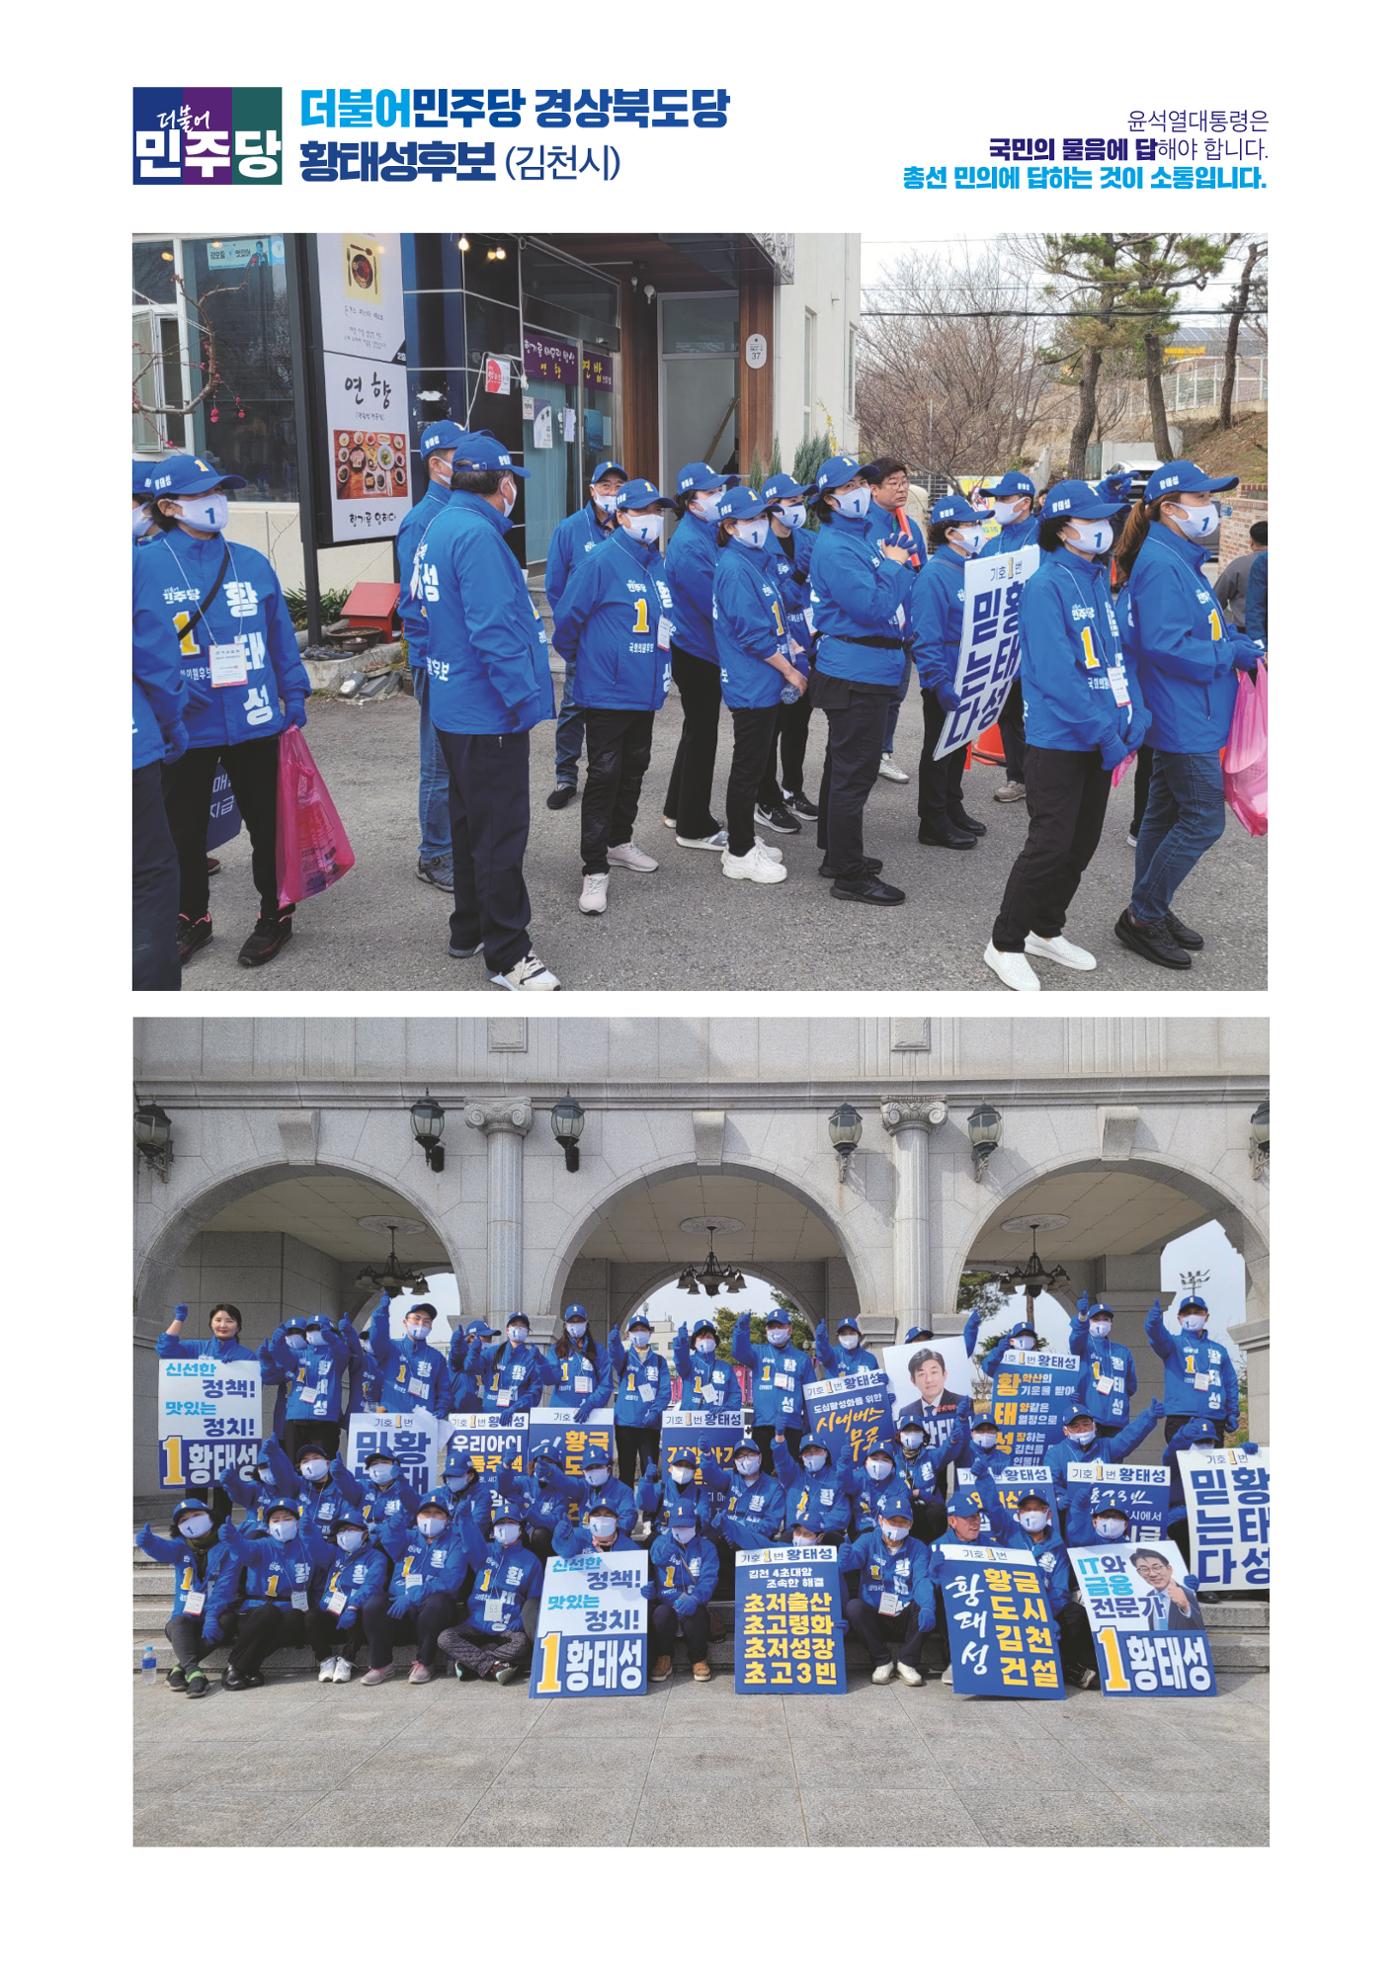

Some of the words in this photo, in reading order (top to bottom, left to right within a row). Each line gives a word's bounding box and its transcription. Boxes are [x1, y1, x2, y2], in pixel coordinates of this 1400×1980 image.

[852, 499, 860, 513] 1
[205, 508, 216, 524] 1
[793, 513, 800, 524] 1
[1201, 516, 1211, 532] 1
[640, 528, 649, 540] 1
[752, 532, 759, 544] 1
[973, 535, 981, 548] 1
[1094, 532, 1103, 548] 1
[990, 566, 1006, 582] 기호
[632, 598, 649, 632] 1
[772, 600, 784, 636] 1
[1208, 608, 1223, 641] 1
[172, 610, 200, 656] 1
[1081, 626, 1101, 669] 1
[944, 588, 1000, 752] 믿는다
[166, 1363, 216, 1377] 신선한
[1038, 1354, 1076, 1369] 황태성
[1184, 1355, 1196, 1374] 1
[396, 1365, 406, 1383] 1
[561, 1363, 569, 1381] 1
[761, 1365, 770, 1381] 1
[844, 1372, 880, 1389] 황태성
[202, 1379, 255, 1398] 정책!
[627, 1374, 635, 1391] 1
[165, 1402, 216, 1415] 맛있는
[554, 1413, 570, 1421] 기호
[994, 1402, 1018, 1425] 태
[203, 1418, 255, 1437] 정치!
[375, 1418, 393, 1427] 기호
[488, 1416, 524, 1427] 황성
[666, 1416, 683, 1424] 기호
[705, 1413, 741, 1426] 황태성
[816, 1407, 885, 1433] 시내버스
[452, 1435, 522, 1452] 우리아이
[163, 1436, 186, 1485] 1
[188, 1444, 258, 1484] 황태성
[1206, 1455, 1226, 1464] 기호
[1004, 1470, 1047, 1481] 황태성
[1072, 1469, 1092, 1478] 기호
[1119, 1468, 1166, 1483] 황태성
[1190, 1469, 1237, 1584] 믿는다
[1232, 1467, 1270, 1584] 황태성
[787, 1548, 833, 1561] 황태성
[402, 1556, 414, 1578] 1
[553, 1557, 602, 1572] 신선한
[749, 1569, 769, 1579] 김천
[1077, 1555, 1127, 1575] IT와
[181, 1566, 193, 1590] 1
[267, 1575, 279, 1597] 1
[481, 1569, 491, 1592] 1
[587, 1570, 641, 1590] 정책!
[665, 1566, 675, 1587] 1
[802, 1578, 824, 1588] 해결
[983, 1568, 1041, 1594] 황금
[1085, 1575, 1134, 1596] 금융
[548, 1594, 599, 1610] 맛있는
[744, 1592, 832, 1612] 초저출산
[990, 1596, 1048, 1622] 도시
[1089, 1597, 1167, 1619] 전문가
[585, 1610, 639, 1632] 정치!
[744, 1614, 834, 1635] 초고령화
[945, 1573, 989, 1675] 황태성
[744, 1637, 835, 1660] 초저성장
[995, 1625, 1054, 1654] 김천
[537, 1631, 562, 1693] 1
[566, 1639, 643, 1692] 황태성
[1097, 1625, 1131, 1691] 1
[1126, 1635, 1211, 1691] 황태성
[744, 1662, 837, 1685] 초고3빈
[1000, 1657, 1059, 1688] 건설
